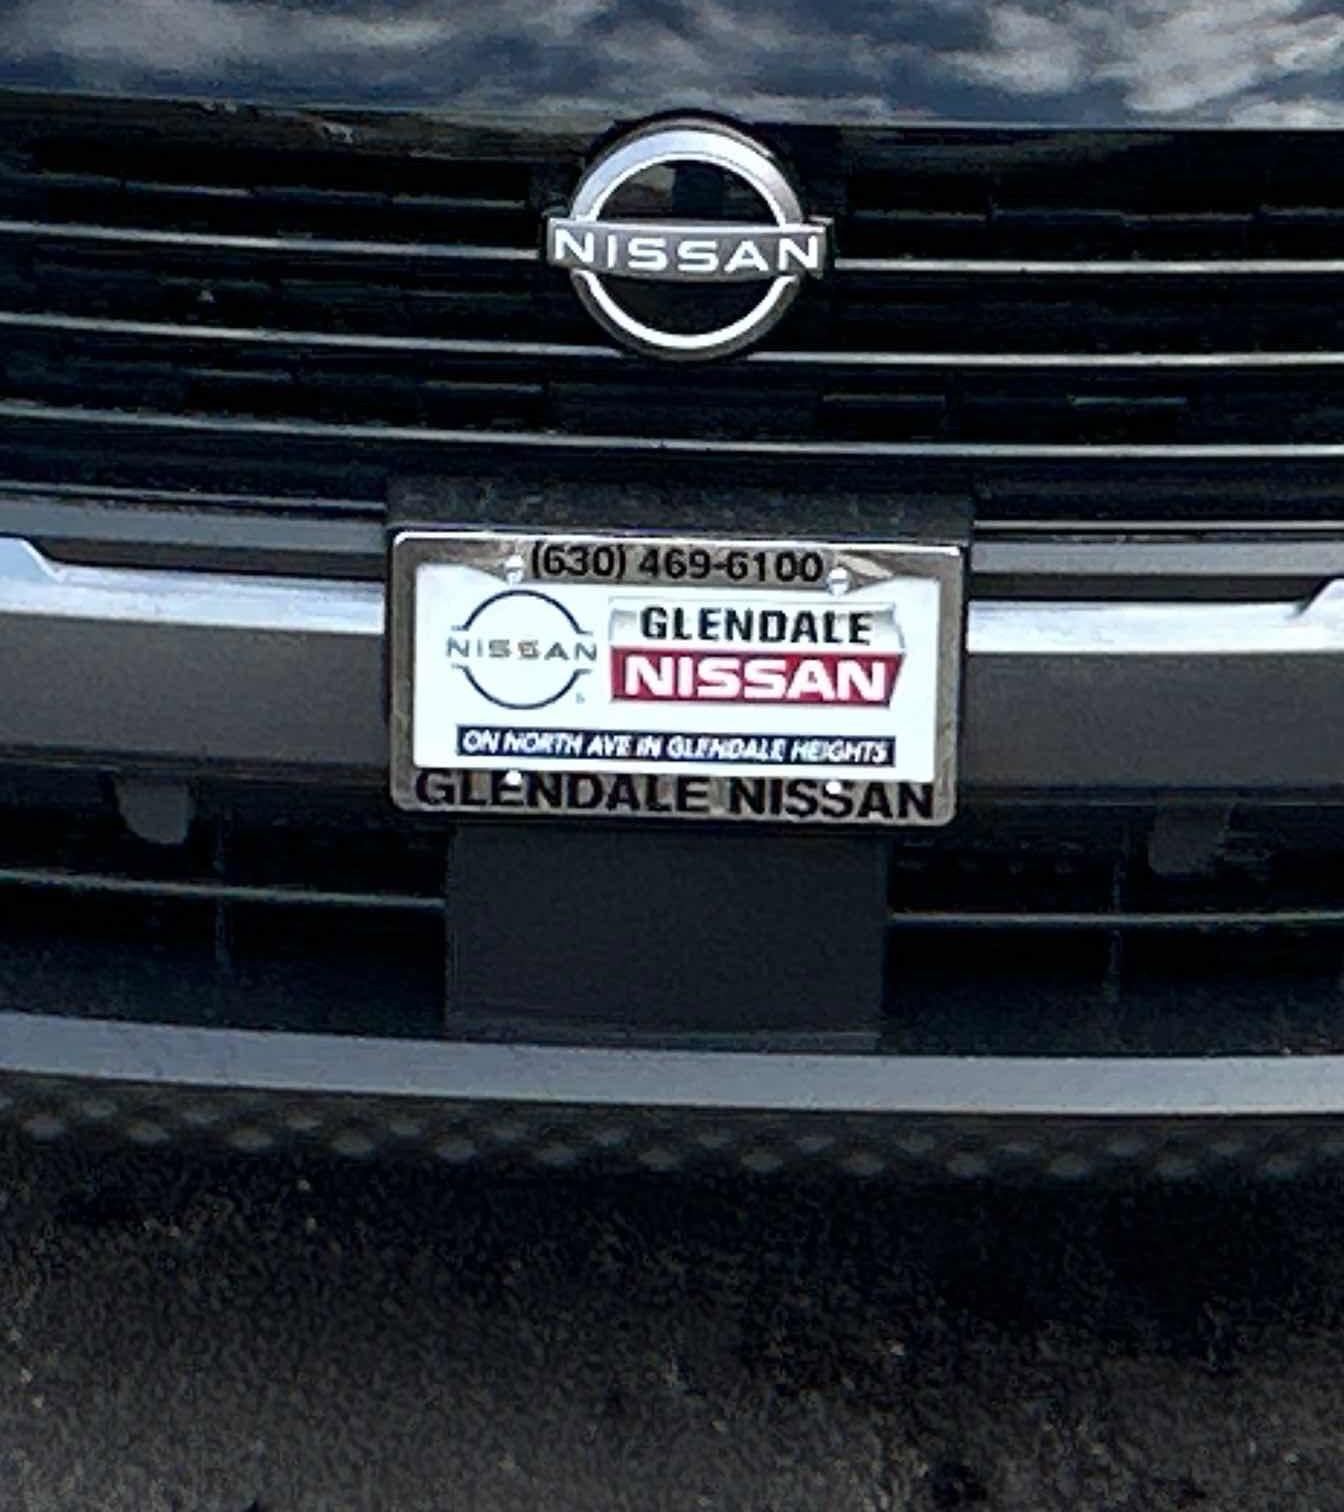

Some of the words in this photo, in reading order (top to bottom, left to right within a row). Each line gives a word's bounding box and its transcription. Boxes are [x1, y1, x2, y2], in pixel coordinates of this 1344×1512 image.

[555, 229, 819, 273] NISSAN
[532, 541, 627, 579] (630)
[639, 548, 825, 584] 469-6100
[641, 606, 873, 646] GLENDALE
[446, 638, 598, 662] NISSAN
[625, 656, 886, 702] NISSAN
[463, 729, 500, 753] ON
[502, 730, 582, 757] NORTH
[586, 734, 633, 758] AVE
[636, 735, 662, 758] IN
[666, 737, 787, 761] GLENDALE
[790, 741, 888, 763] HEIGHTS
[416, 768, 710, 814] GLENDALE
[728, 776, 934, 819] NISSAN
